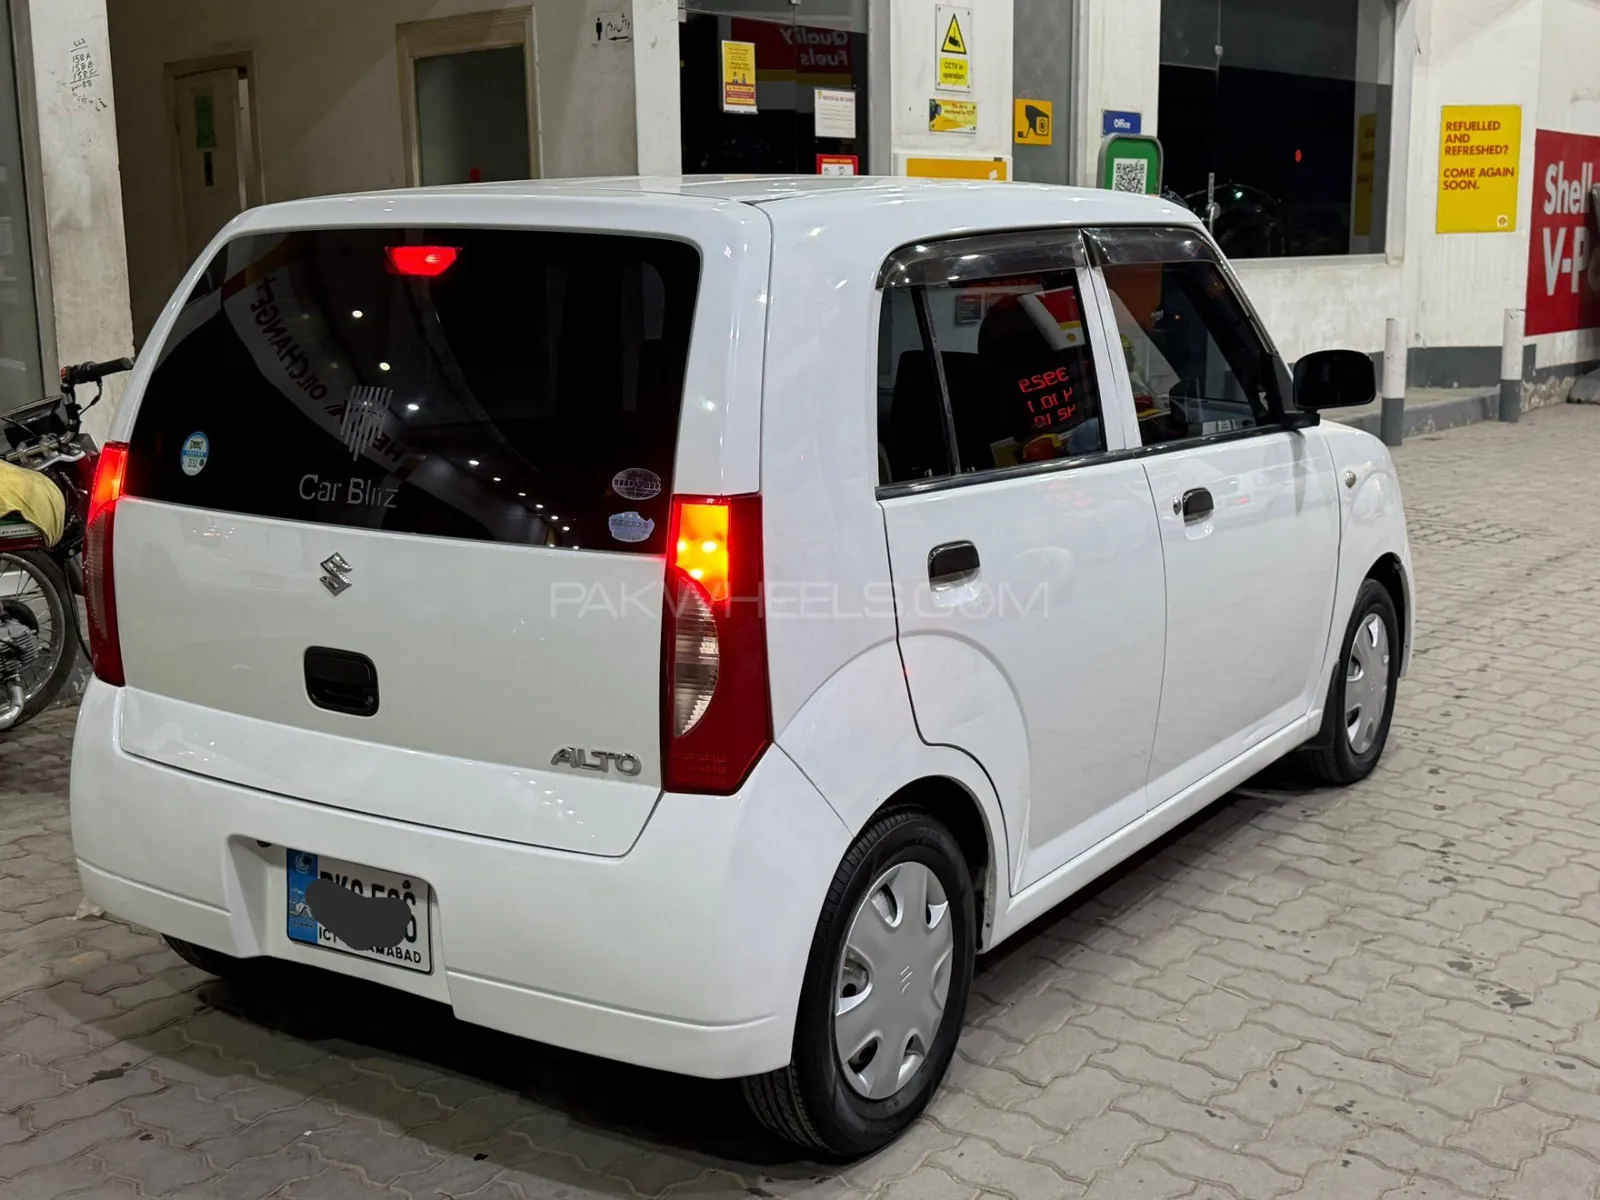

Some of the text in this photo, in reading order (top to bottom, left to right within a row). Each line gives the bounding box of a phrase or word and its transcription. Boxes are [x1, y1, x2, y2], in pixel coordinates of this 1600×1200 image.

[944, 61, 958, 70] CCTV
[1113, 118, 1131, 129] Office
[1446, 121, 1501, 132] REFUELLED
[1445, 133, 1470, 144] AND
[1444, 145, 1509, 156] REFRESHED?
[1443, 167, 1515, 178] COME AGAIN
[1443, 180, 1480, 191] SOON.
[1543, 160, 1593, 215] Shell
[299, 474, 342, 501] Car
[550, 747, 642, 777] ALTO
